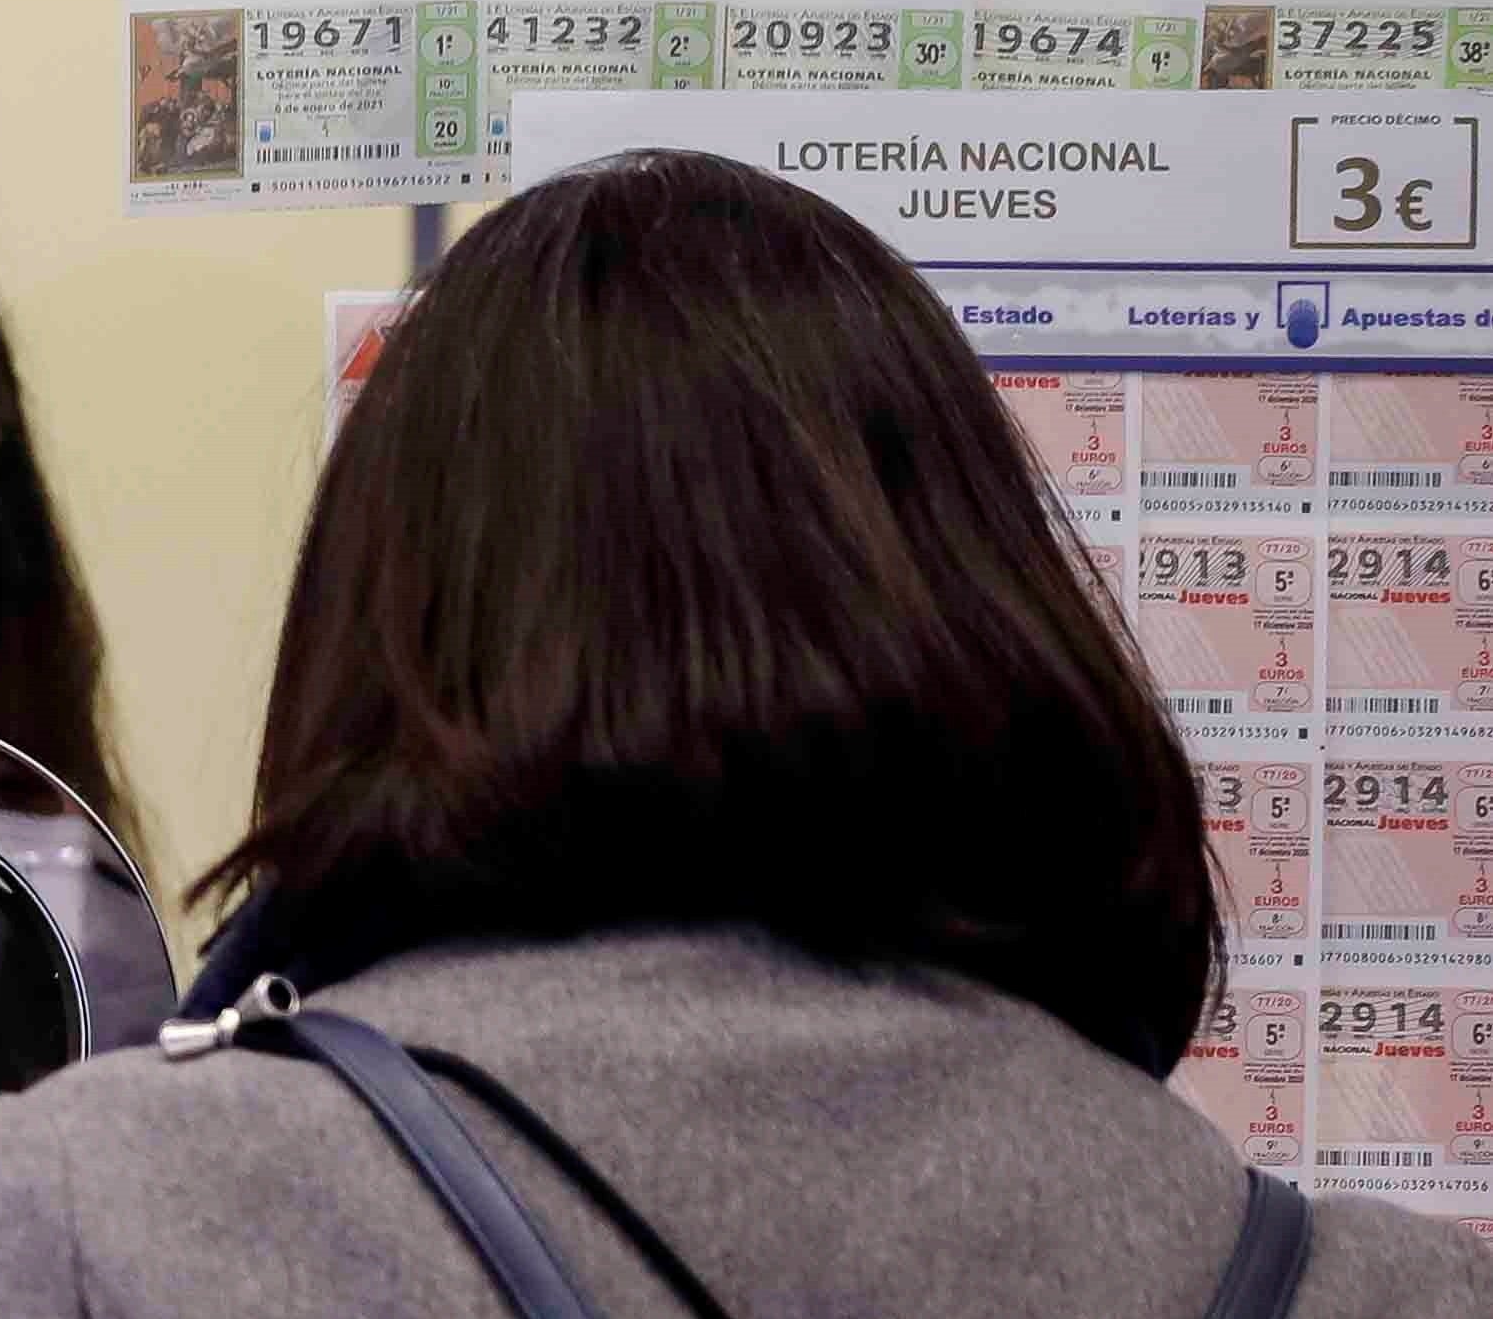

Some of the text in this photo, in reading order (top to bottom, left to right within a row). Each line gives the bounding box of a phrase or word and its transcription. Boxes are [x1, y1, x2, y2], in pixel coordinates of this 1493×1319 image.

[777, 135, 1171, 173] LOTERÍA NACIONAL
[898, 189, 1057, 220] JUEVES
[1332, 156, 1434, 233] 3 €
[1128, 306, 1260, 331] Loterías y
[1328, 549, 1451, 580] 2914
[1380, 588, 1451, 604] Jueves
